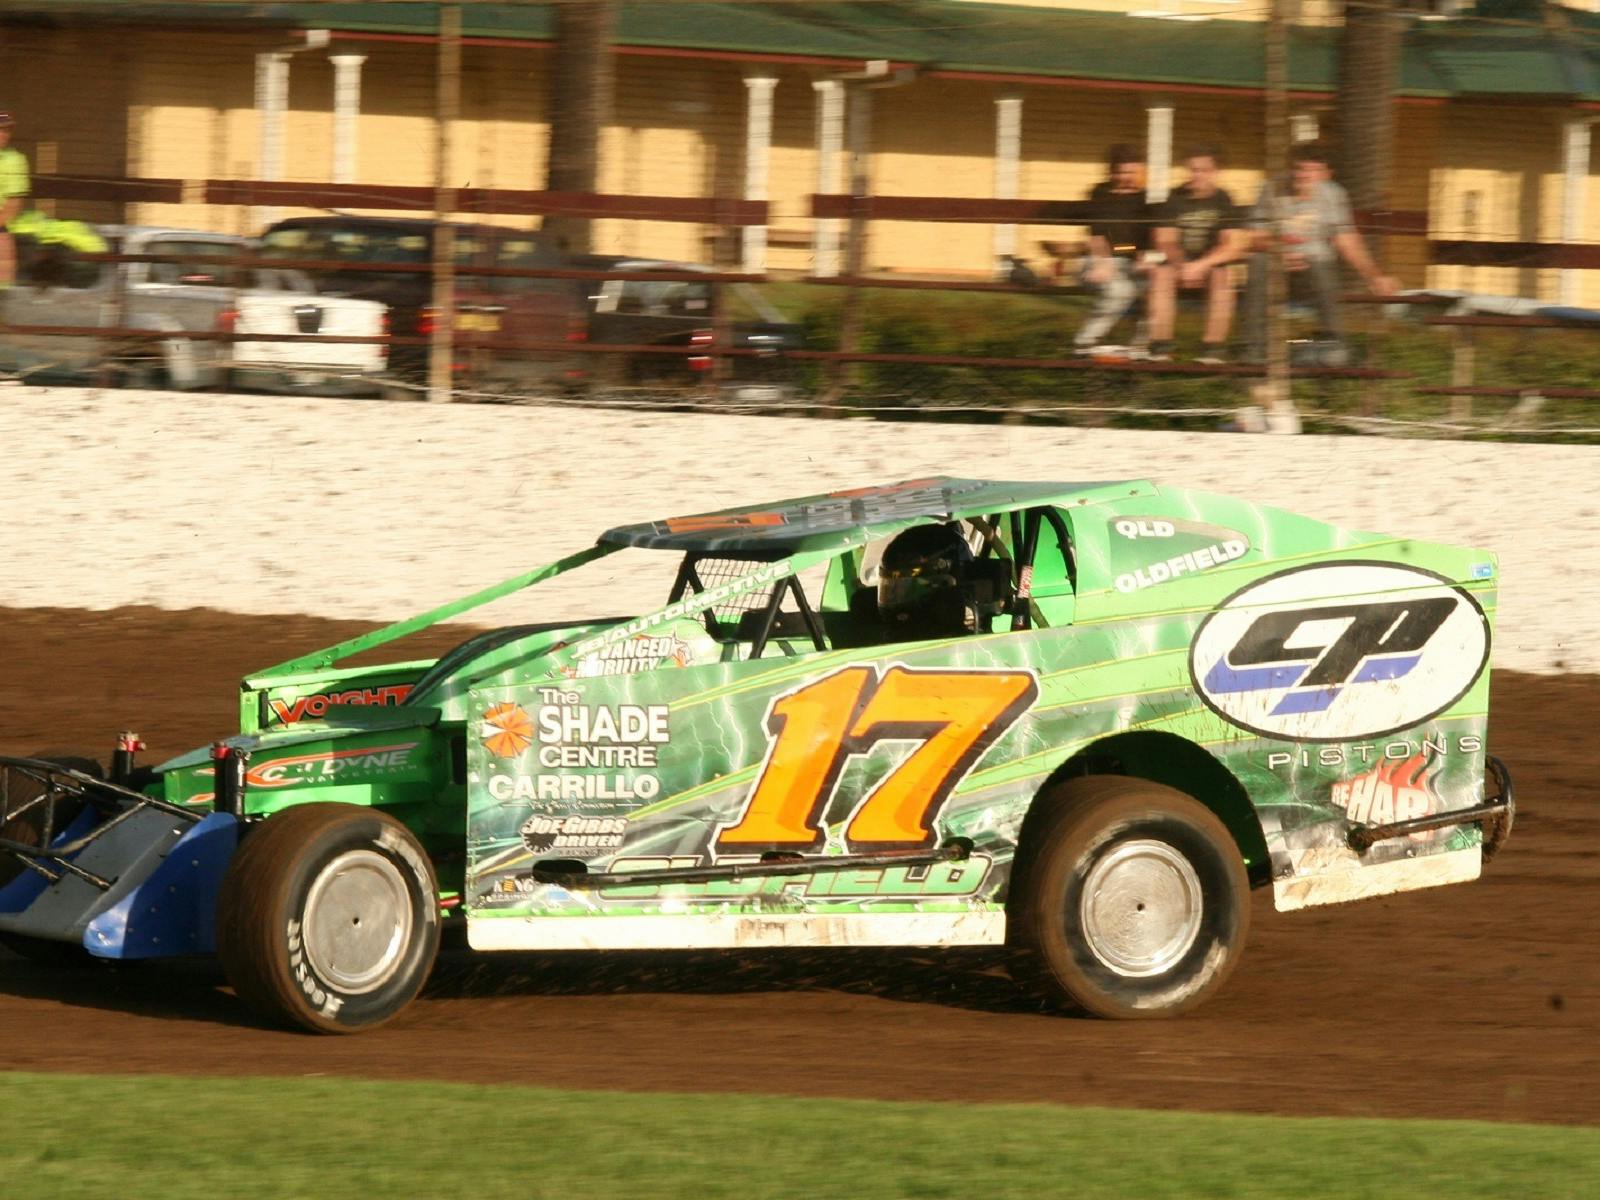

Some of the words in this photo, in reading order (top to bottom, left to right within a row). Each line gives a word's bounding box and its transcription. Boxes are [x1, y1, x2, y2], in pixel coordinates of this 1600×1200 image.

[1115, 520, 1175, 540] QLD
[1115, 539, 1247, 593] OLDFIELD
[538, 688, 580, 704] The
[538, 704, 670, 743] SHADE
[538, 746, 658, 768] CENTRE
[711, 662, 1037, 850] 17
[1268, 736, 1483, 770] PISTONS
[488, 774, 660, 801] CARRILLO
[553, 834, 623, 848] DRIVEN
